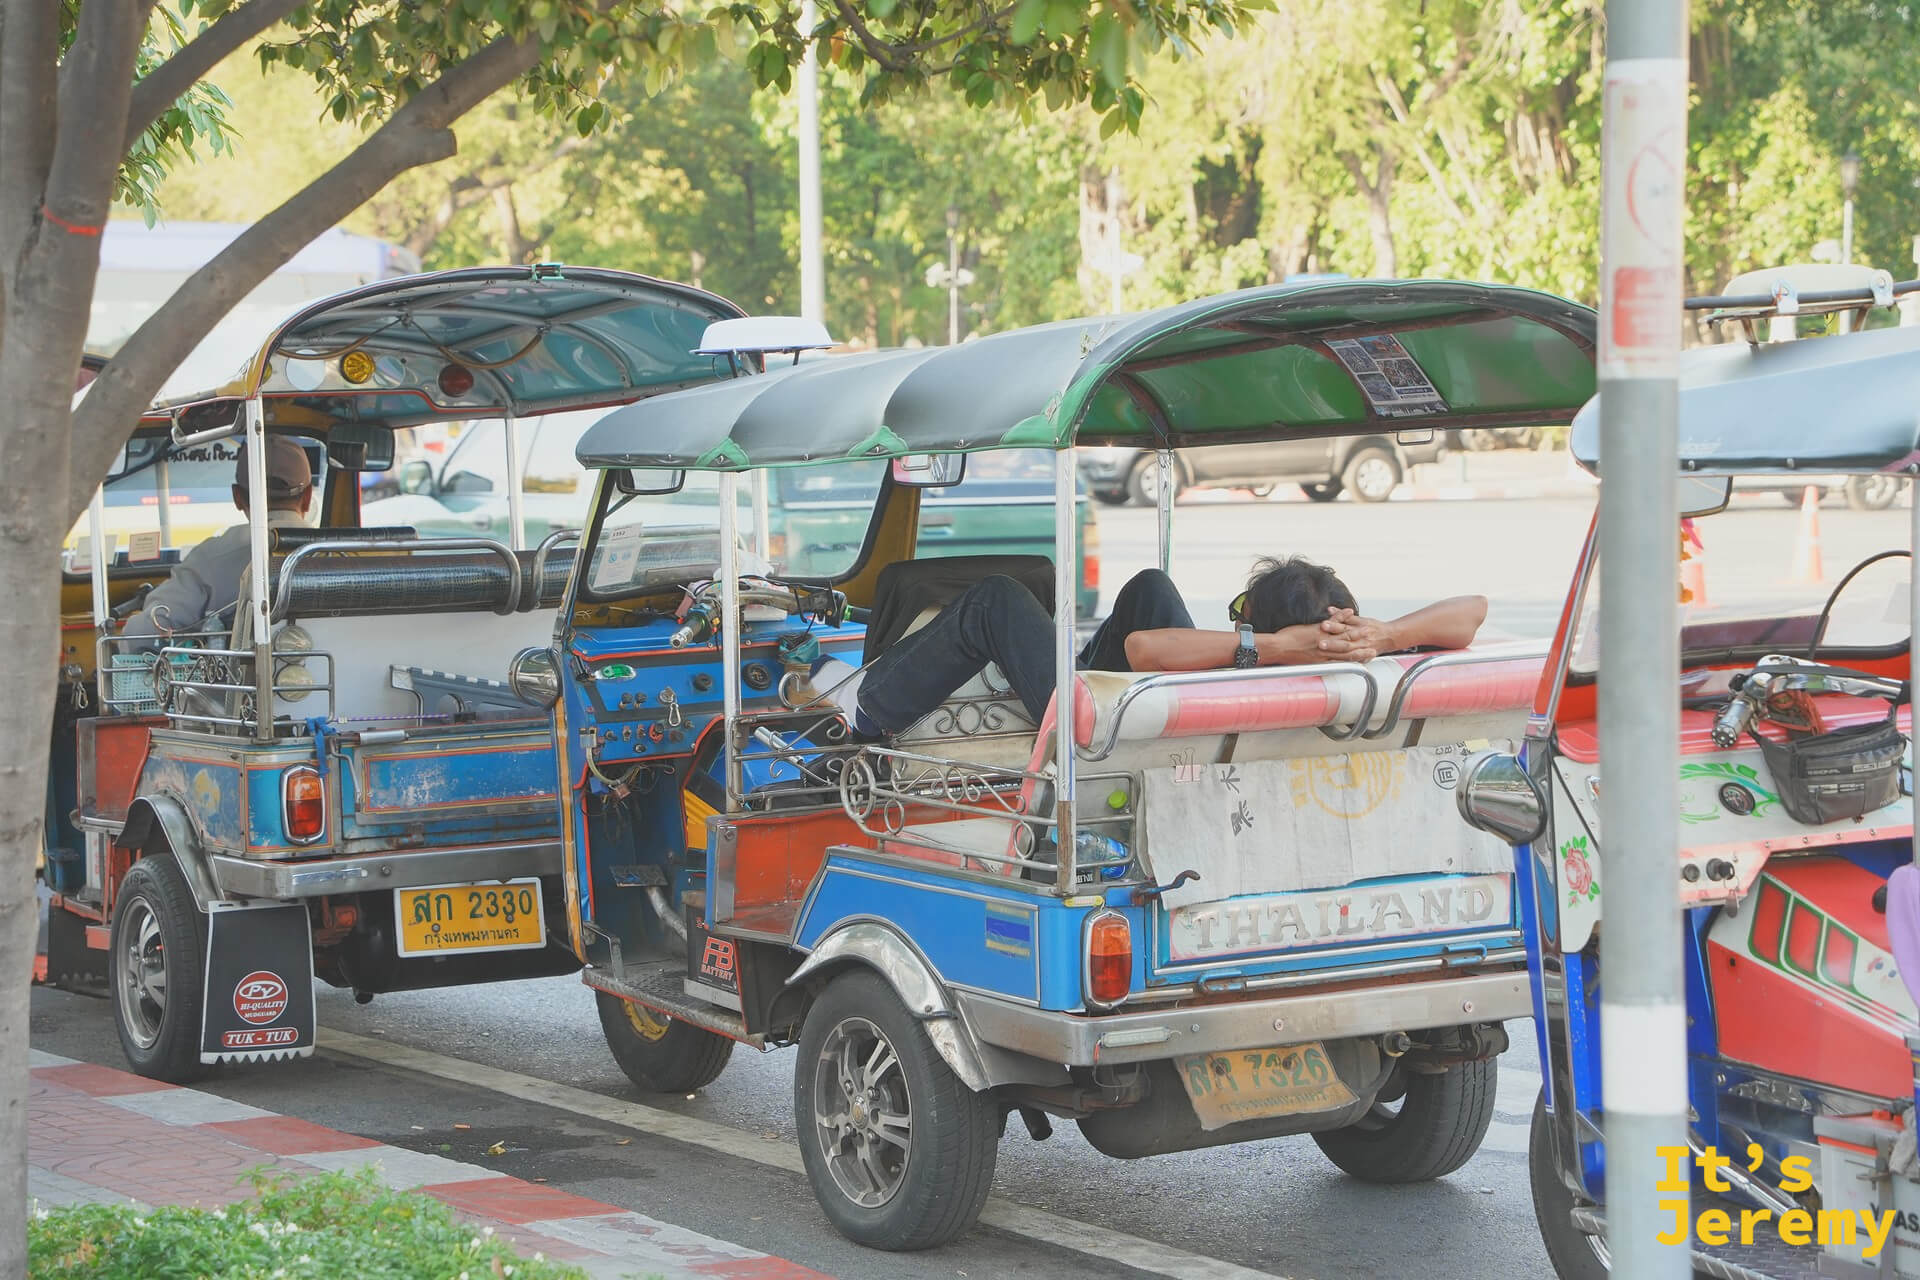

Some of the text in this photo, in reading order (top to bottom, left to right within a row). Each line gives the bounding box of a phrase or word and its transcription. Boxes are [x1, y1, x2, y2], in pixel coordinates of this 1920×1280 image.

[468, 888, 533, 919] 2330
[1191, 883, 1495, 949] THAILAND
[424, 928, 520, 947] กรุงเทพมหานคร
[240, 1000, 285, 1011] HI-QUALITY
[1243, 1047, 1330, 1090] 7326
